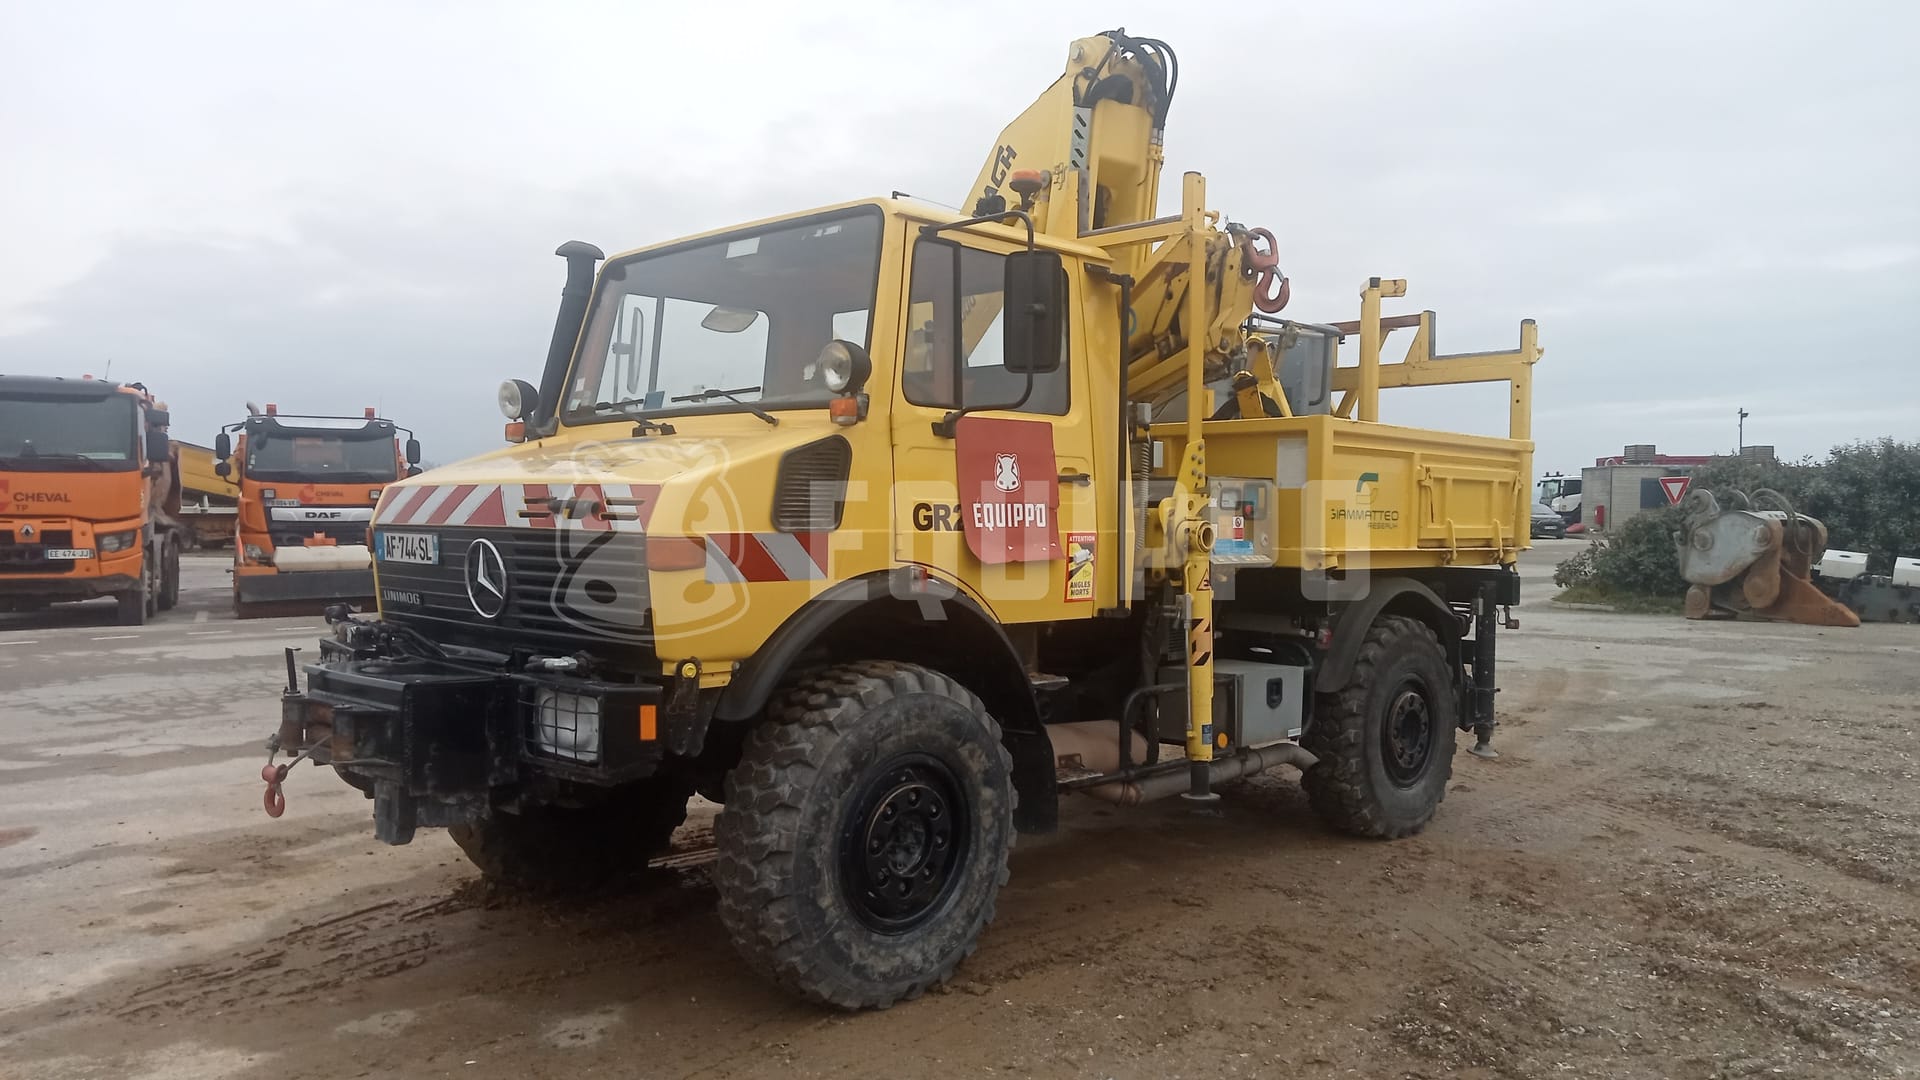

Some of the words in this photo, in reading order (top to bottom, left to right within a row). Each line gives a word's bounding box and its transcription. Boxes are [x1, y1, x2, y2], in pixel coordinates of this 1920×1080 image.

[13, 492, 71, 503] CHEVAL
[15, 504, 29, 512] TP
[972, 503, 1047, 531] EQUIPPO
[383, 590, 420, 605] UNIMOG
